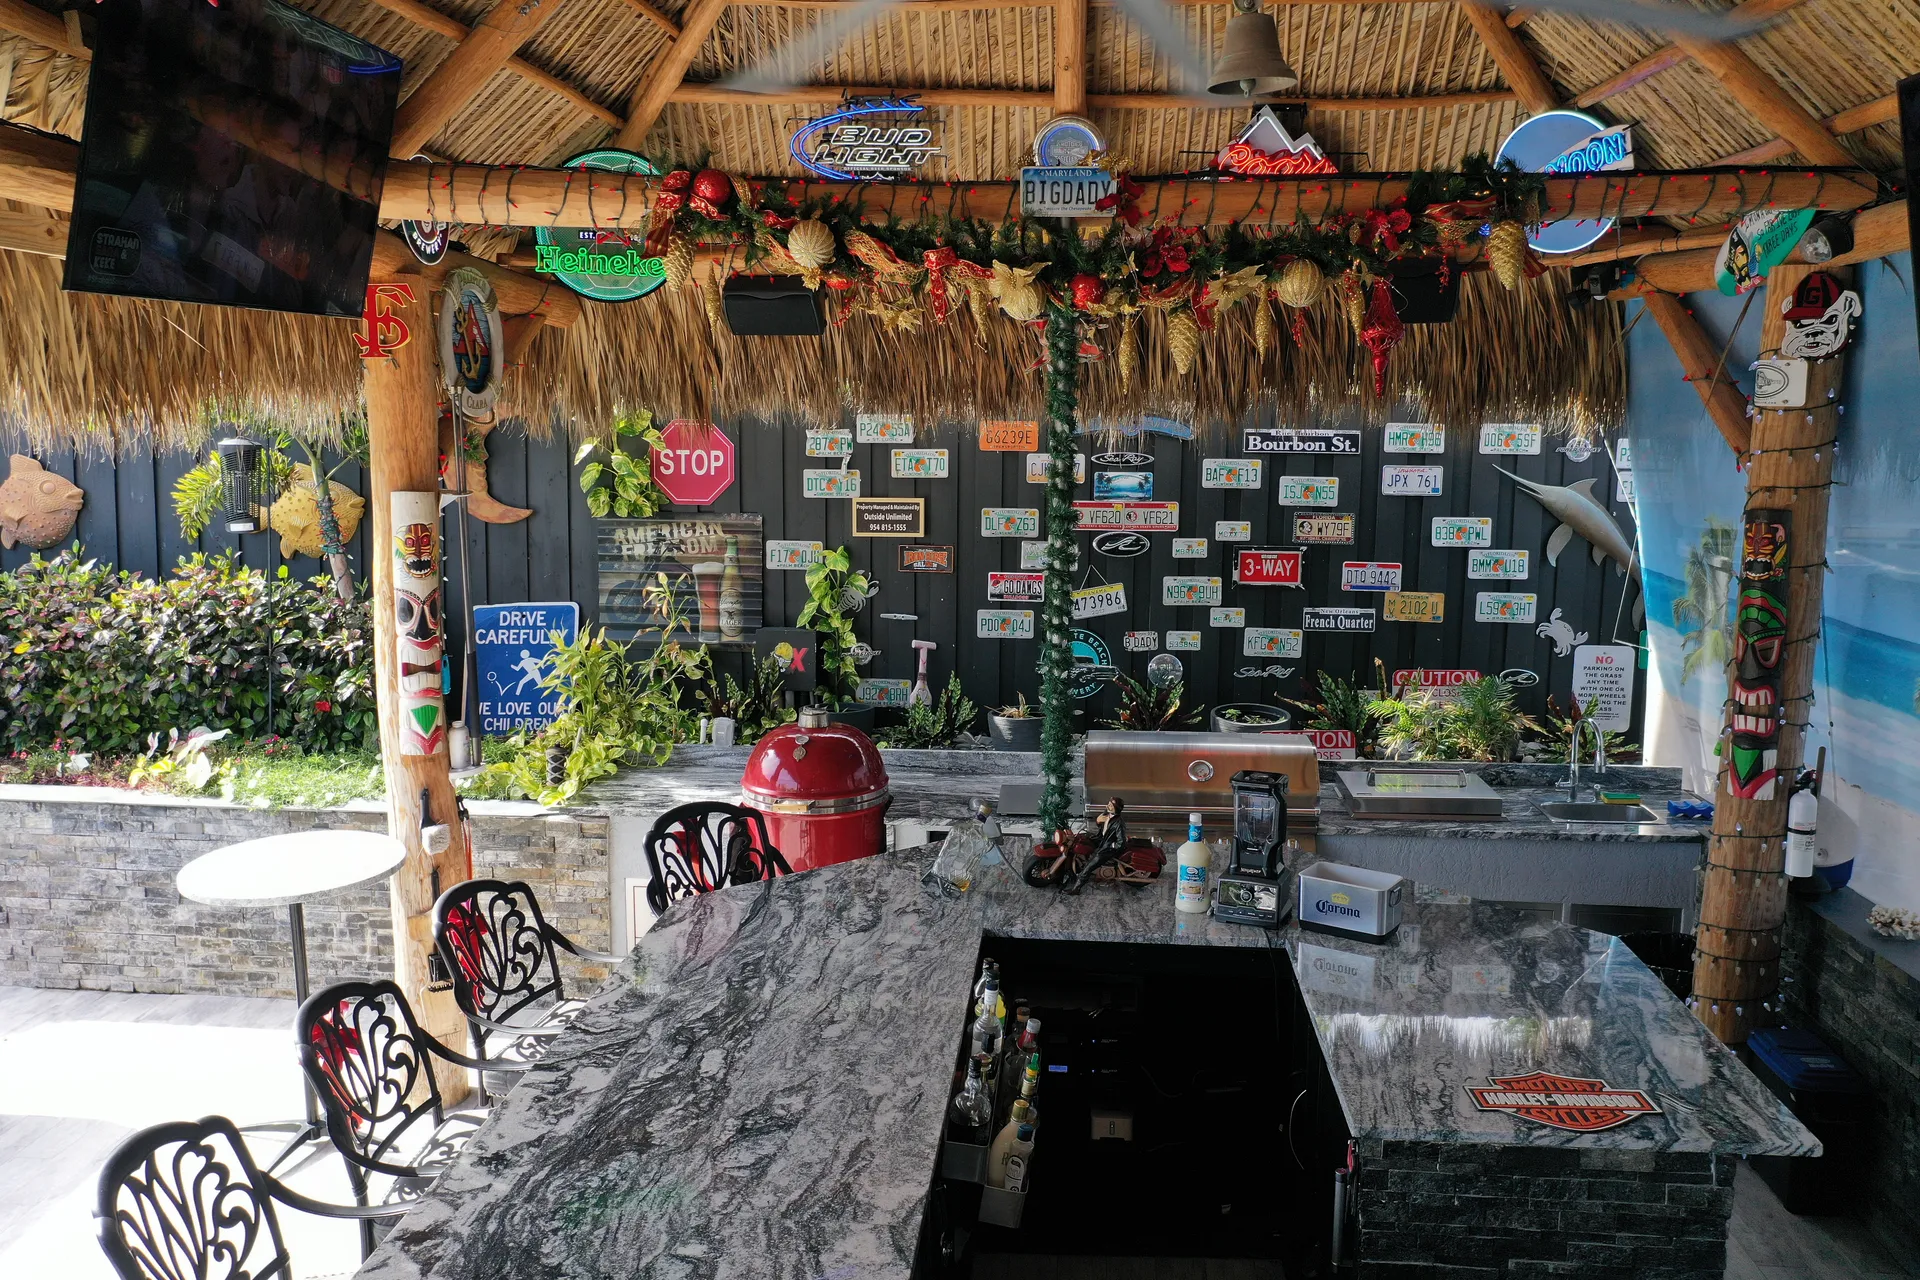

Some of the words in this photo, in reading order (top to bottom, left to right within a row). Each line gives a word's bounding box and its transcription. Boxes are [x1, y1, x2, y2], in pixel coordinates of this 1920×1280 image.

[831, 125, 931, 145] BUD
[811, 144, 943, 165] LIGHT
[1025, 181, 1111, 204] BIGDADY
[534, 245, 665, 279] Heineke
[860, 423, 878, 436] P24
[986, 430, 1032, 444] G6239E
[1248, 435, 1327, 452] Bourbon
[1331, 436, 1356, 452] St.
[1388, 432, 1408, 446] HMR
[659, 450, 724, 476] STOP
[894, 457, 914, 471] ETA
[927, 457, 945, 471] T70
[1206, 468, 1224, 482] BAF
[1238, 468, 1258, 482] F13
[1387, 474, 1408, 488] JPX
[1418, 474, 1437, 488] 761
[807, 478, 826, 491] DTC
[886, 513, 912, 521] Unlimited
[1088, 510, 1121, 524] VF620
[1142, 510, 1174, 524] VF621
[984, 518, 1004, 531] DLF
[1016, 518, 1036, 531] Z63
[614, 521, 725, 546] AMERICAN
[1468, 526, 1488, 540] PWL
[770, 550, 788, 562] F17
[1244, 558, 1294, 576] 3-WAY
[1472, 558, 1492, 573] BMM
[1504, 558, 1524, 573] U18
[1370, 570, 1398, 586] 9442
[1004, 580, 1014, 594] GO
[1016, 580, 1042, 594] DAWGS
[1166, 585, 1186, 599] N96
[1198, 586, 1218, 599] 9UH
[1400, 600, 1428, 615] 2102
[1431, 601, 1438, 614] U
[1480, 601, 1500, 616] L59
[1512, 602, 1532, 616] 3HT
[500, 611, 546, 626] DRIVE
[1304, 615, 1336, 628] French
[1337, 615, 1374, 629] Quarter
[1134, 636, 1158, 648] DADY
[1248, 636, 1266, 649] KFG
[1088, 638, 1108, 666] BEACH
[1596, 656, 1614, 664] NO
[1396, 671, 1478, 686] CAUTION
[498, 702, 532, 716] LOVE
[1316, 899, 1360, 918] Corona
[1482, 1092, 1643, 1108] HARLEY-DAVIDSON
